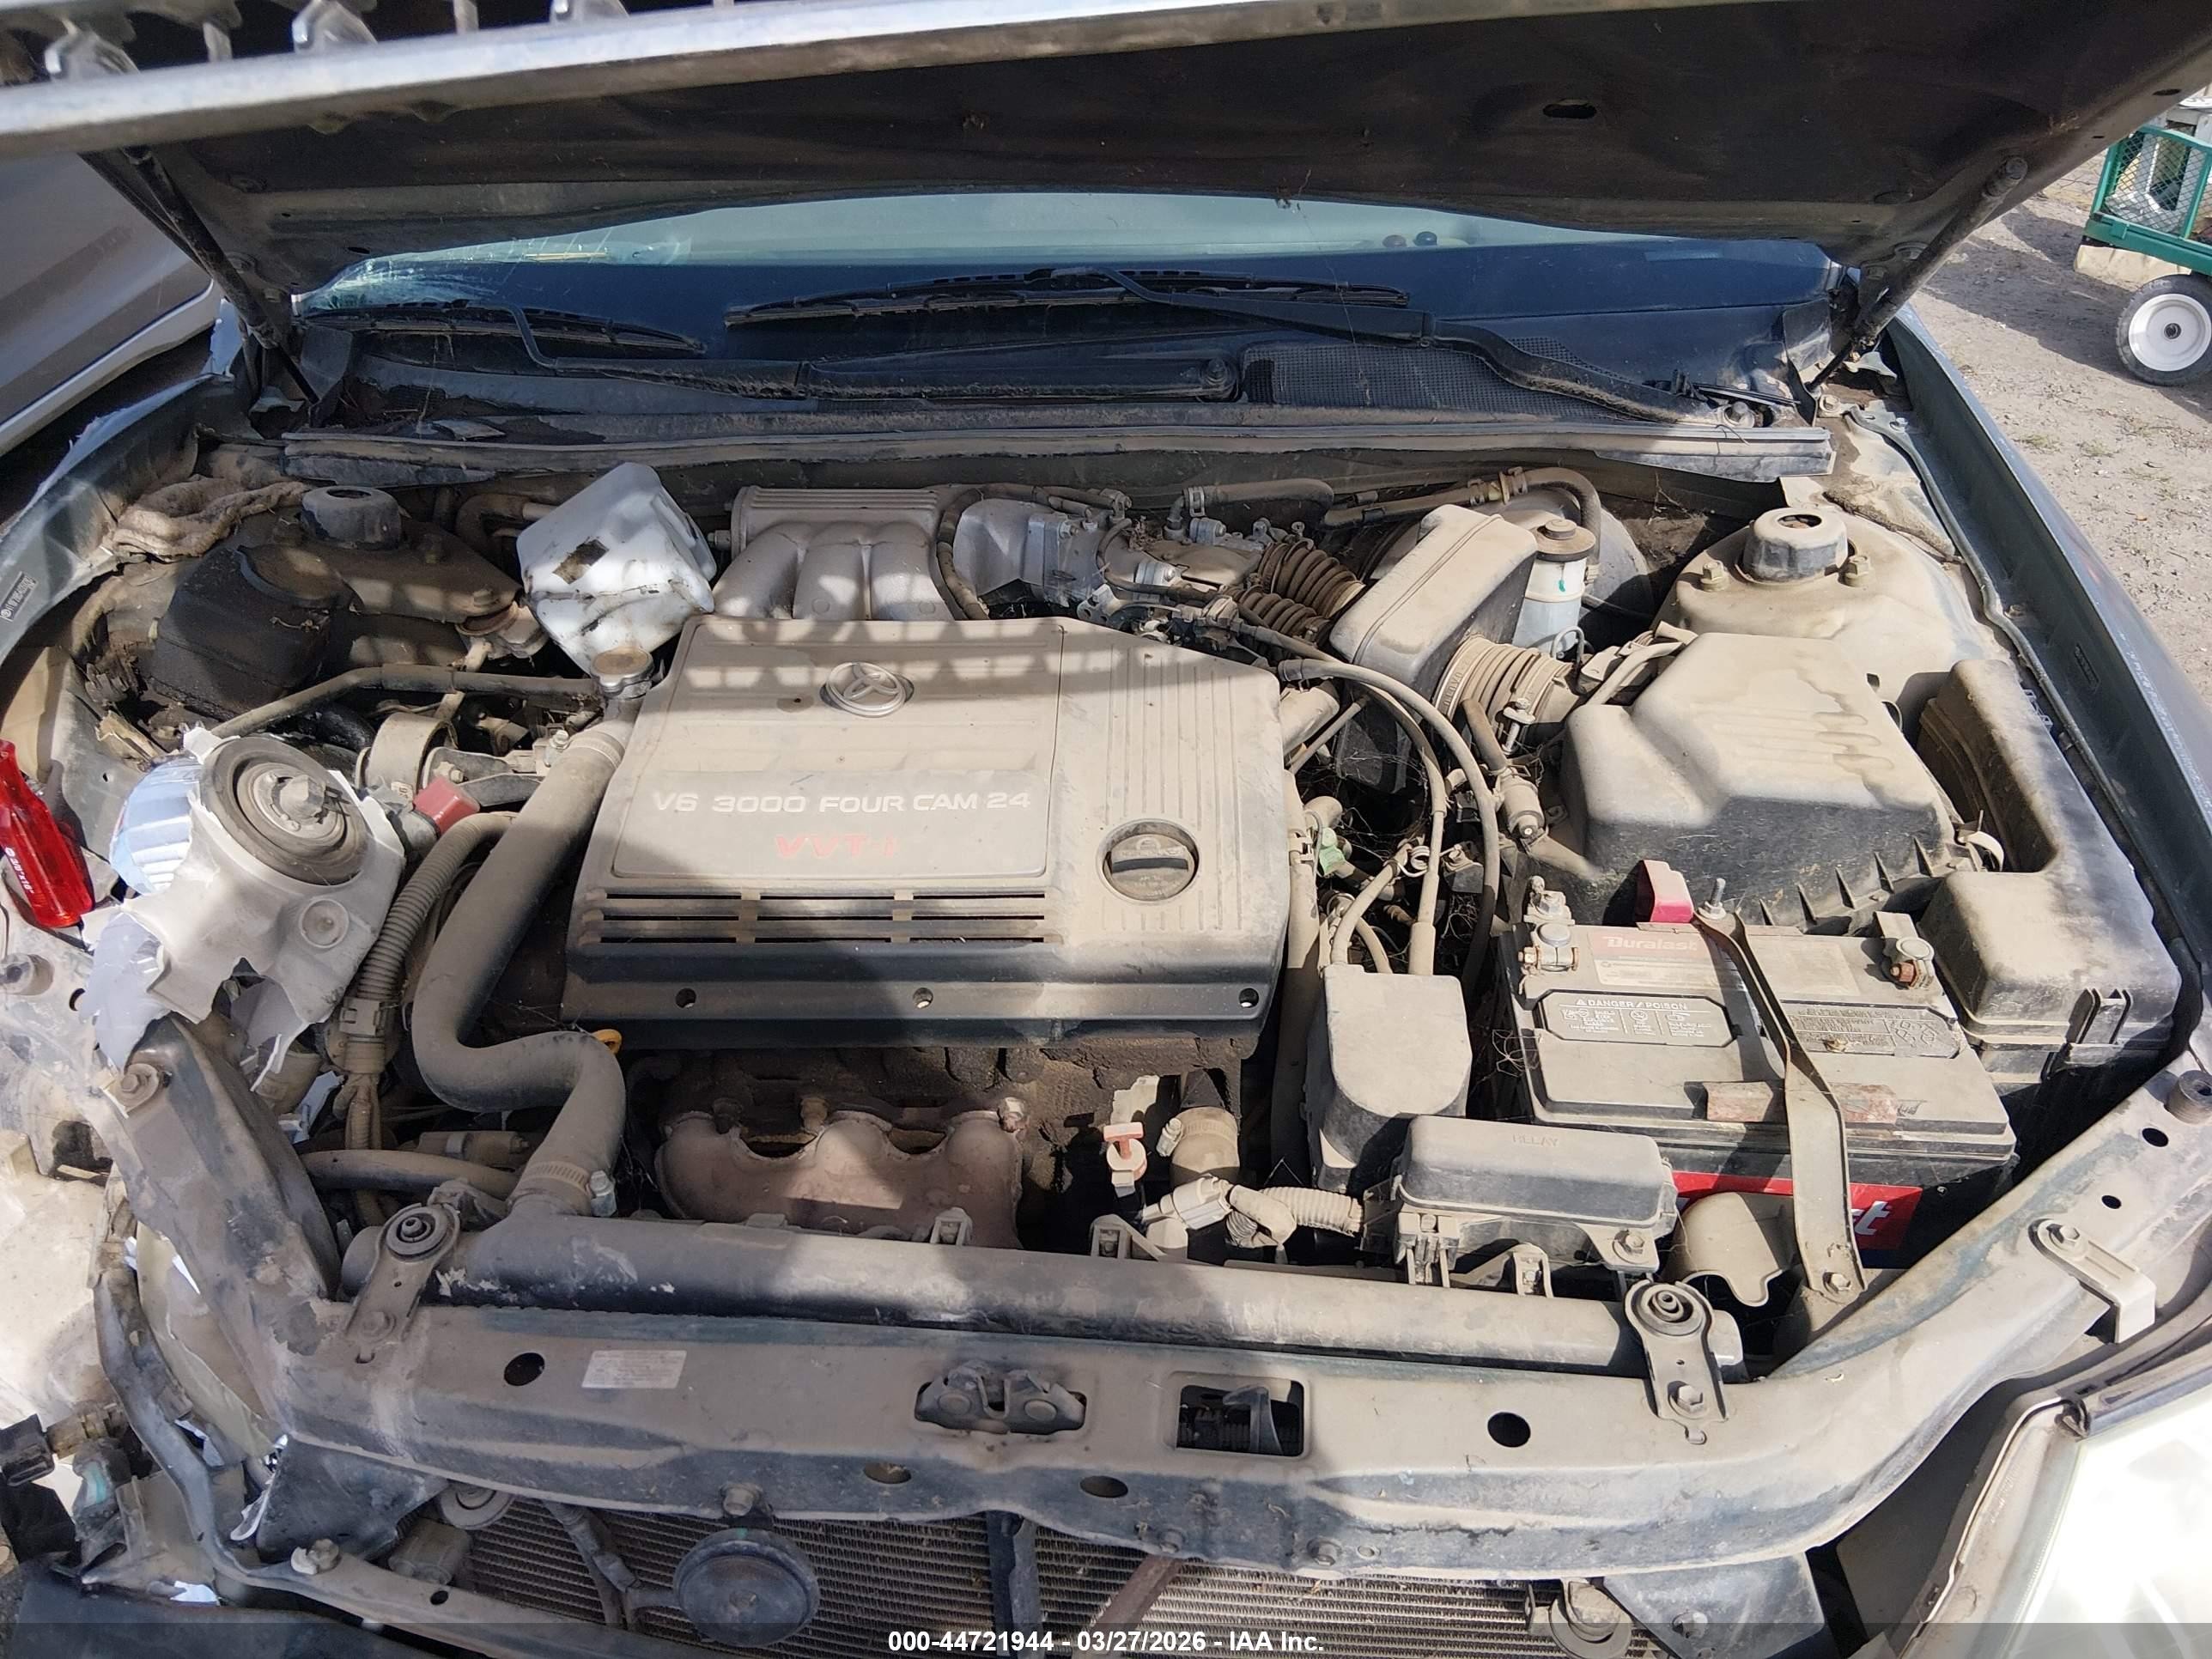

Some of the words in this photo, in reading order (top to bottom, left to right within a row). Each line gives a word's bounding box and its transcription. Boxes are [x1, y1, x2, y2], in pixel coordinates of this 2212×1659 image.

[653, 793, 699, 811] V6
[712, 795, 806, 812] 3000
[818, 795, 905, 812] FOUR
[913, 793, 977, 811] CAM
[987, 792, 1031, 808] 24
[1602, 935, 1698, 951] Duralast
[1512, 1133, 1559, 1147] RELAY
